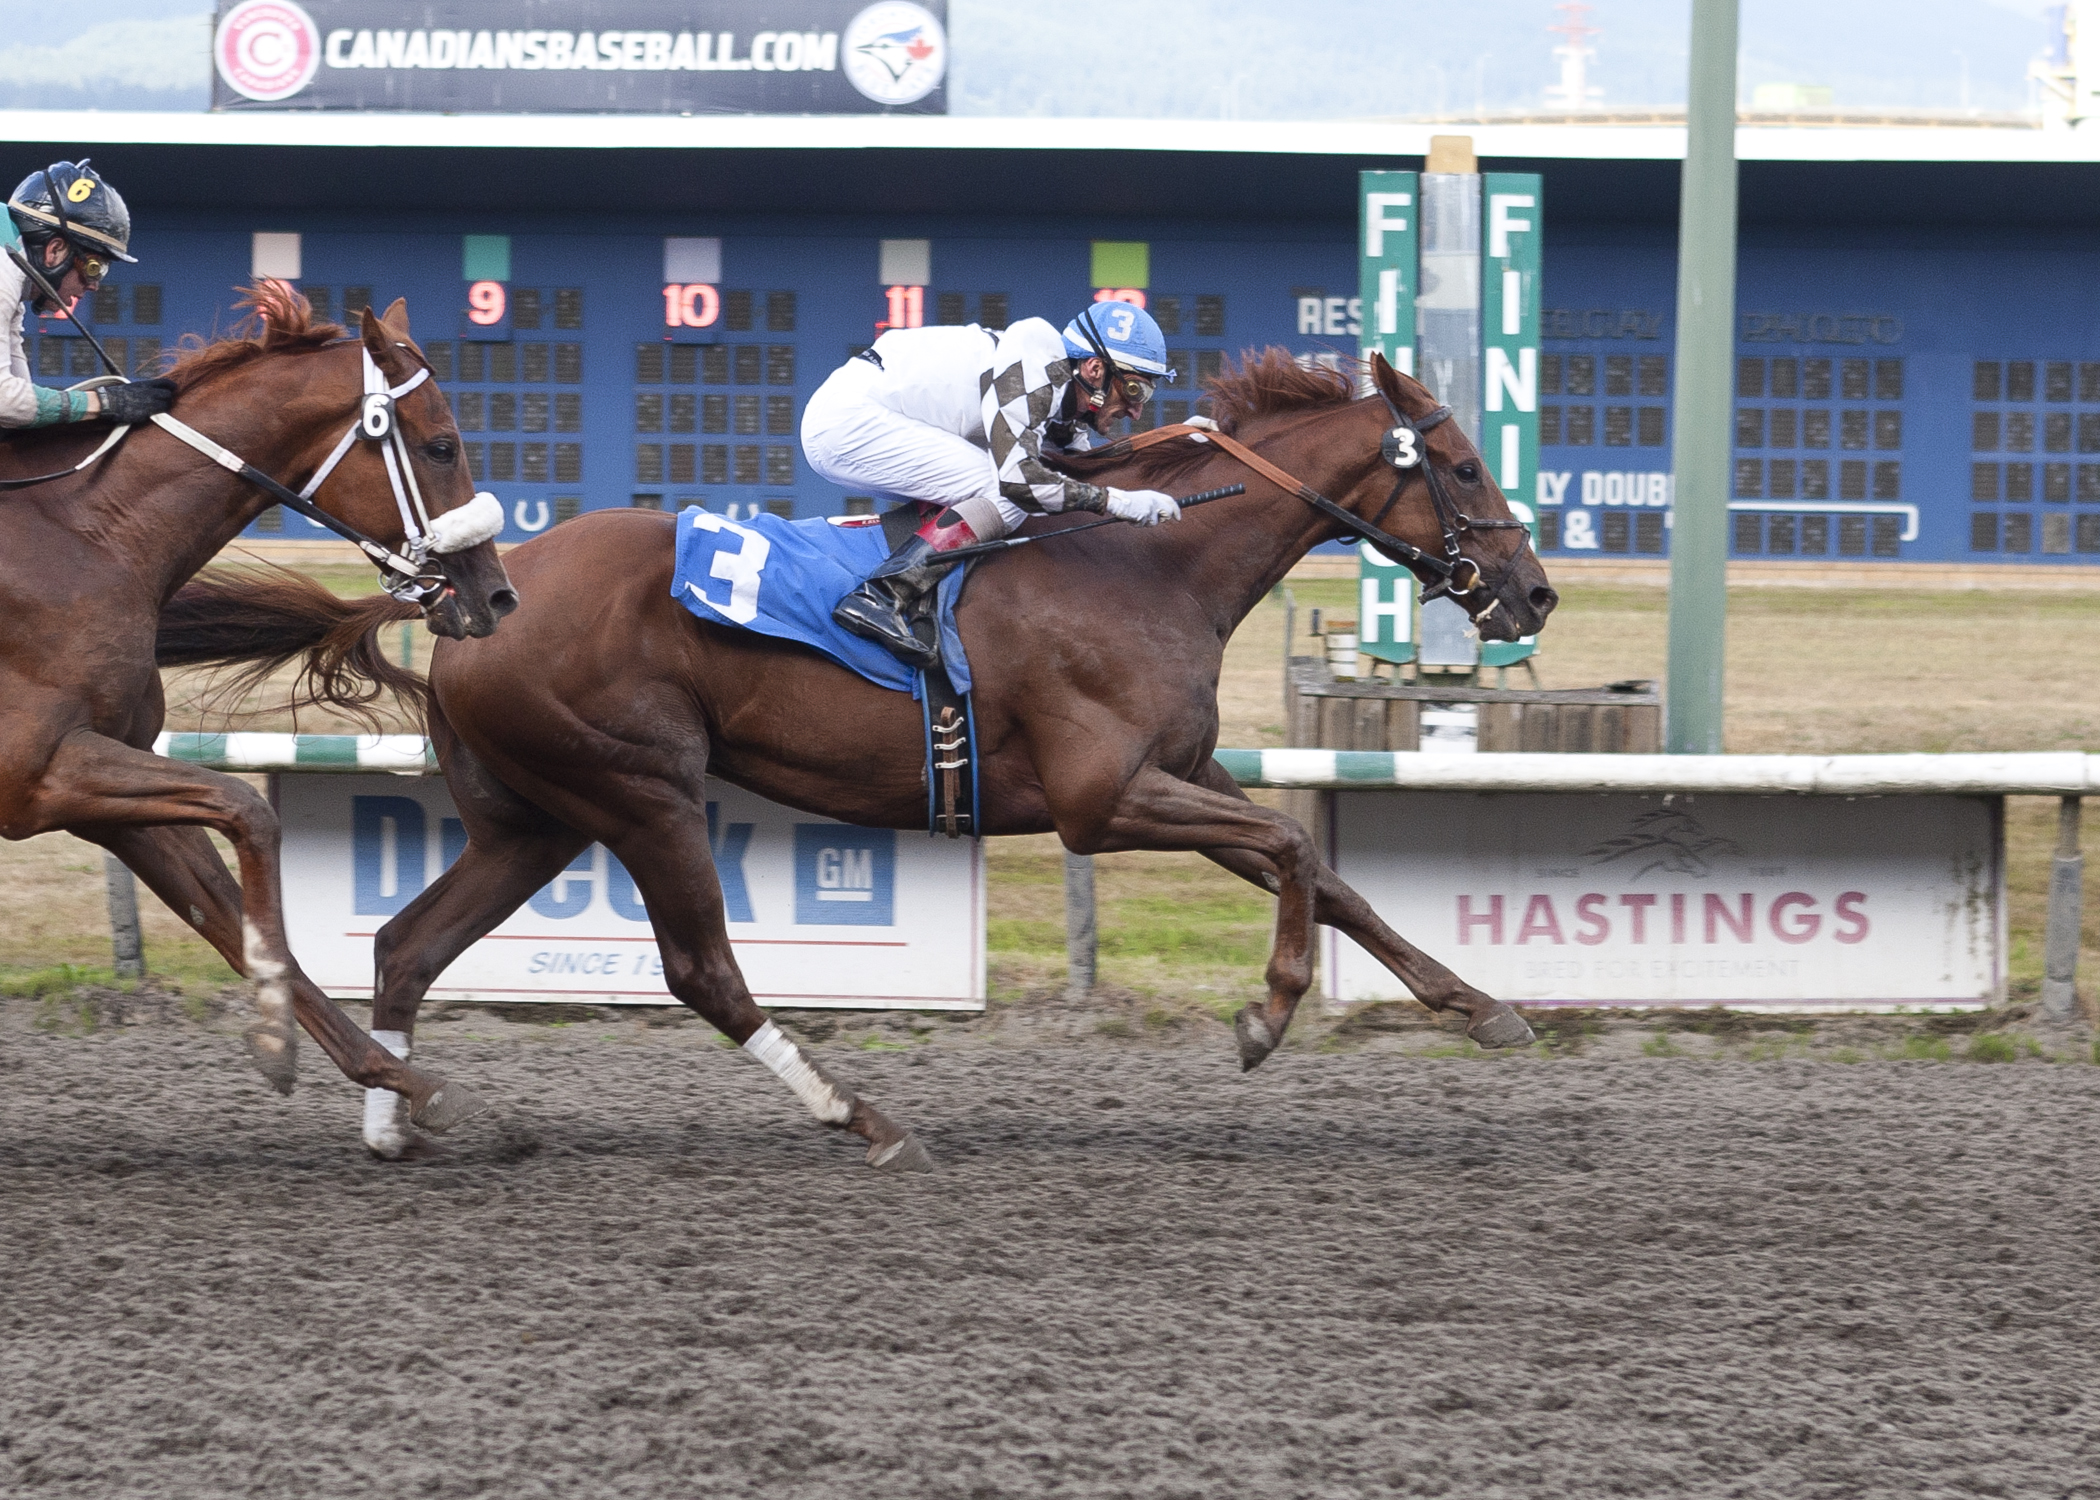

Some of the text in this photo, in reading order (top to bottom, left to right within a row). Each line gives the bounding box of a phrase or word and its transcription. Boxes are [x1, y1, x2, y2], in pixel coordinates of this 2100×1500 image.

[324, 29, 837, 72] CANADIANSBASEBALL.COM
[67, 178, 95, 203] 6
[468, 280, 506, 326] 9
[662, 283, 720, 328] 10
[885, 285, 924, 329] 11
[1297, 297, 1362, 335] RES
[1107, 308, 1135, 342] 3
[363, 394, 390, 436] 6
[1485, 194, 1536, 645] FINI
[1392, 427, 1418, 466] 3
[1537, 472, 1675, 506] LY DOUB
[1563, 510, 1599, 549] &
[684, 513, 770, 625] 3
[815, 847, 873, 885] GM
[1455, 889, 1870, 946] HASTINGS
[528, 951, 665, 976] SINCE 19
[1594, 959, 1643, 979] FOR
